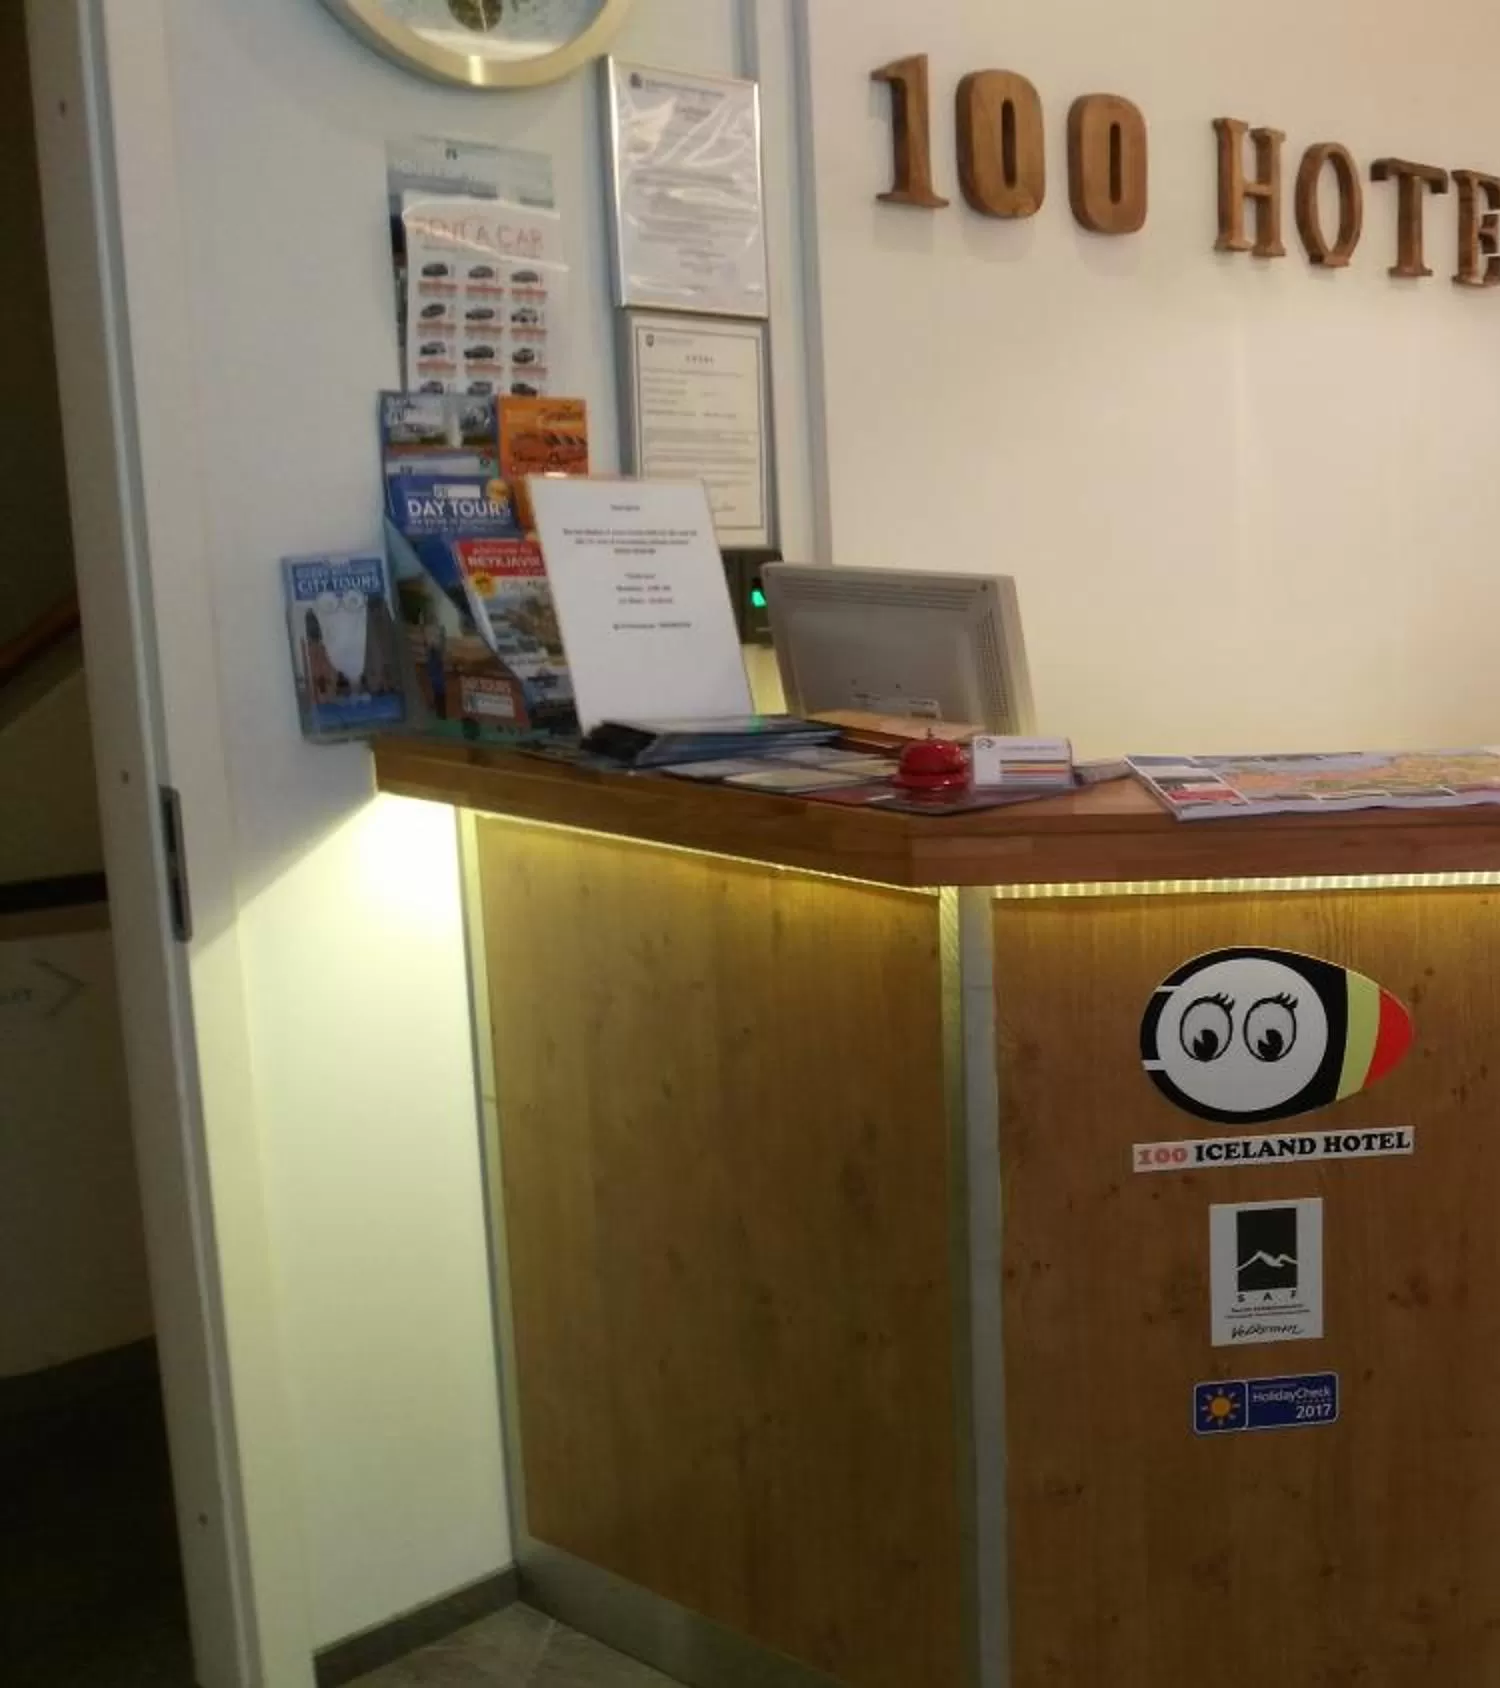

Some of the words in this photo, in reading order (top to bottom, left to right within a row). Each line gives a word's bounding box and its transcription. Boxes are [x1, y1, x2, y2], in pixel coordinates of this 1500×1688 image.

[870, 52, 1149, 236] 100
[407, 498, 445, 518] DAY
[1137, 1146, 1189, 1166] 100
[1195, 1136, 1317, 1163] ICELAND
[1323, 1130, 1411, 1153] HOTEL
[1252, 1385, 1331, 1404] HolidayCheck
[1295, 1403, 1332, 1420] 2017
